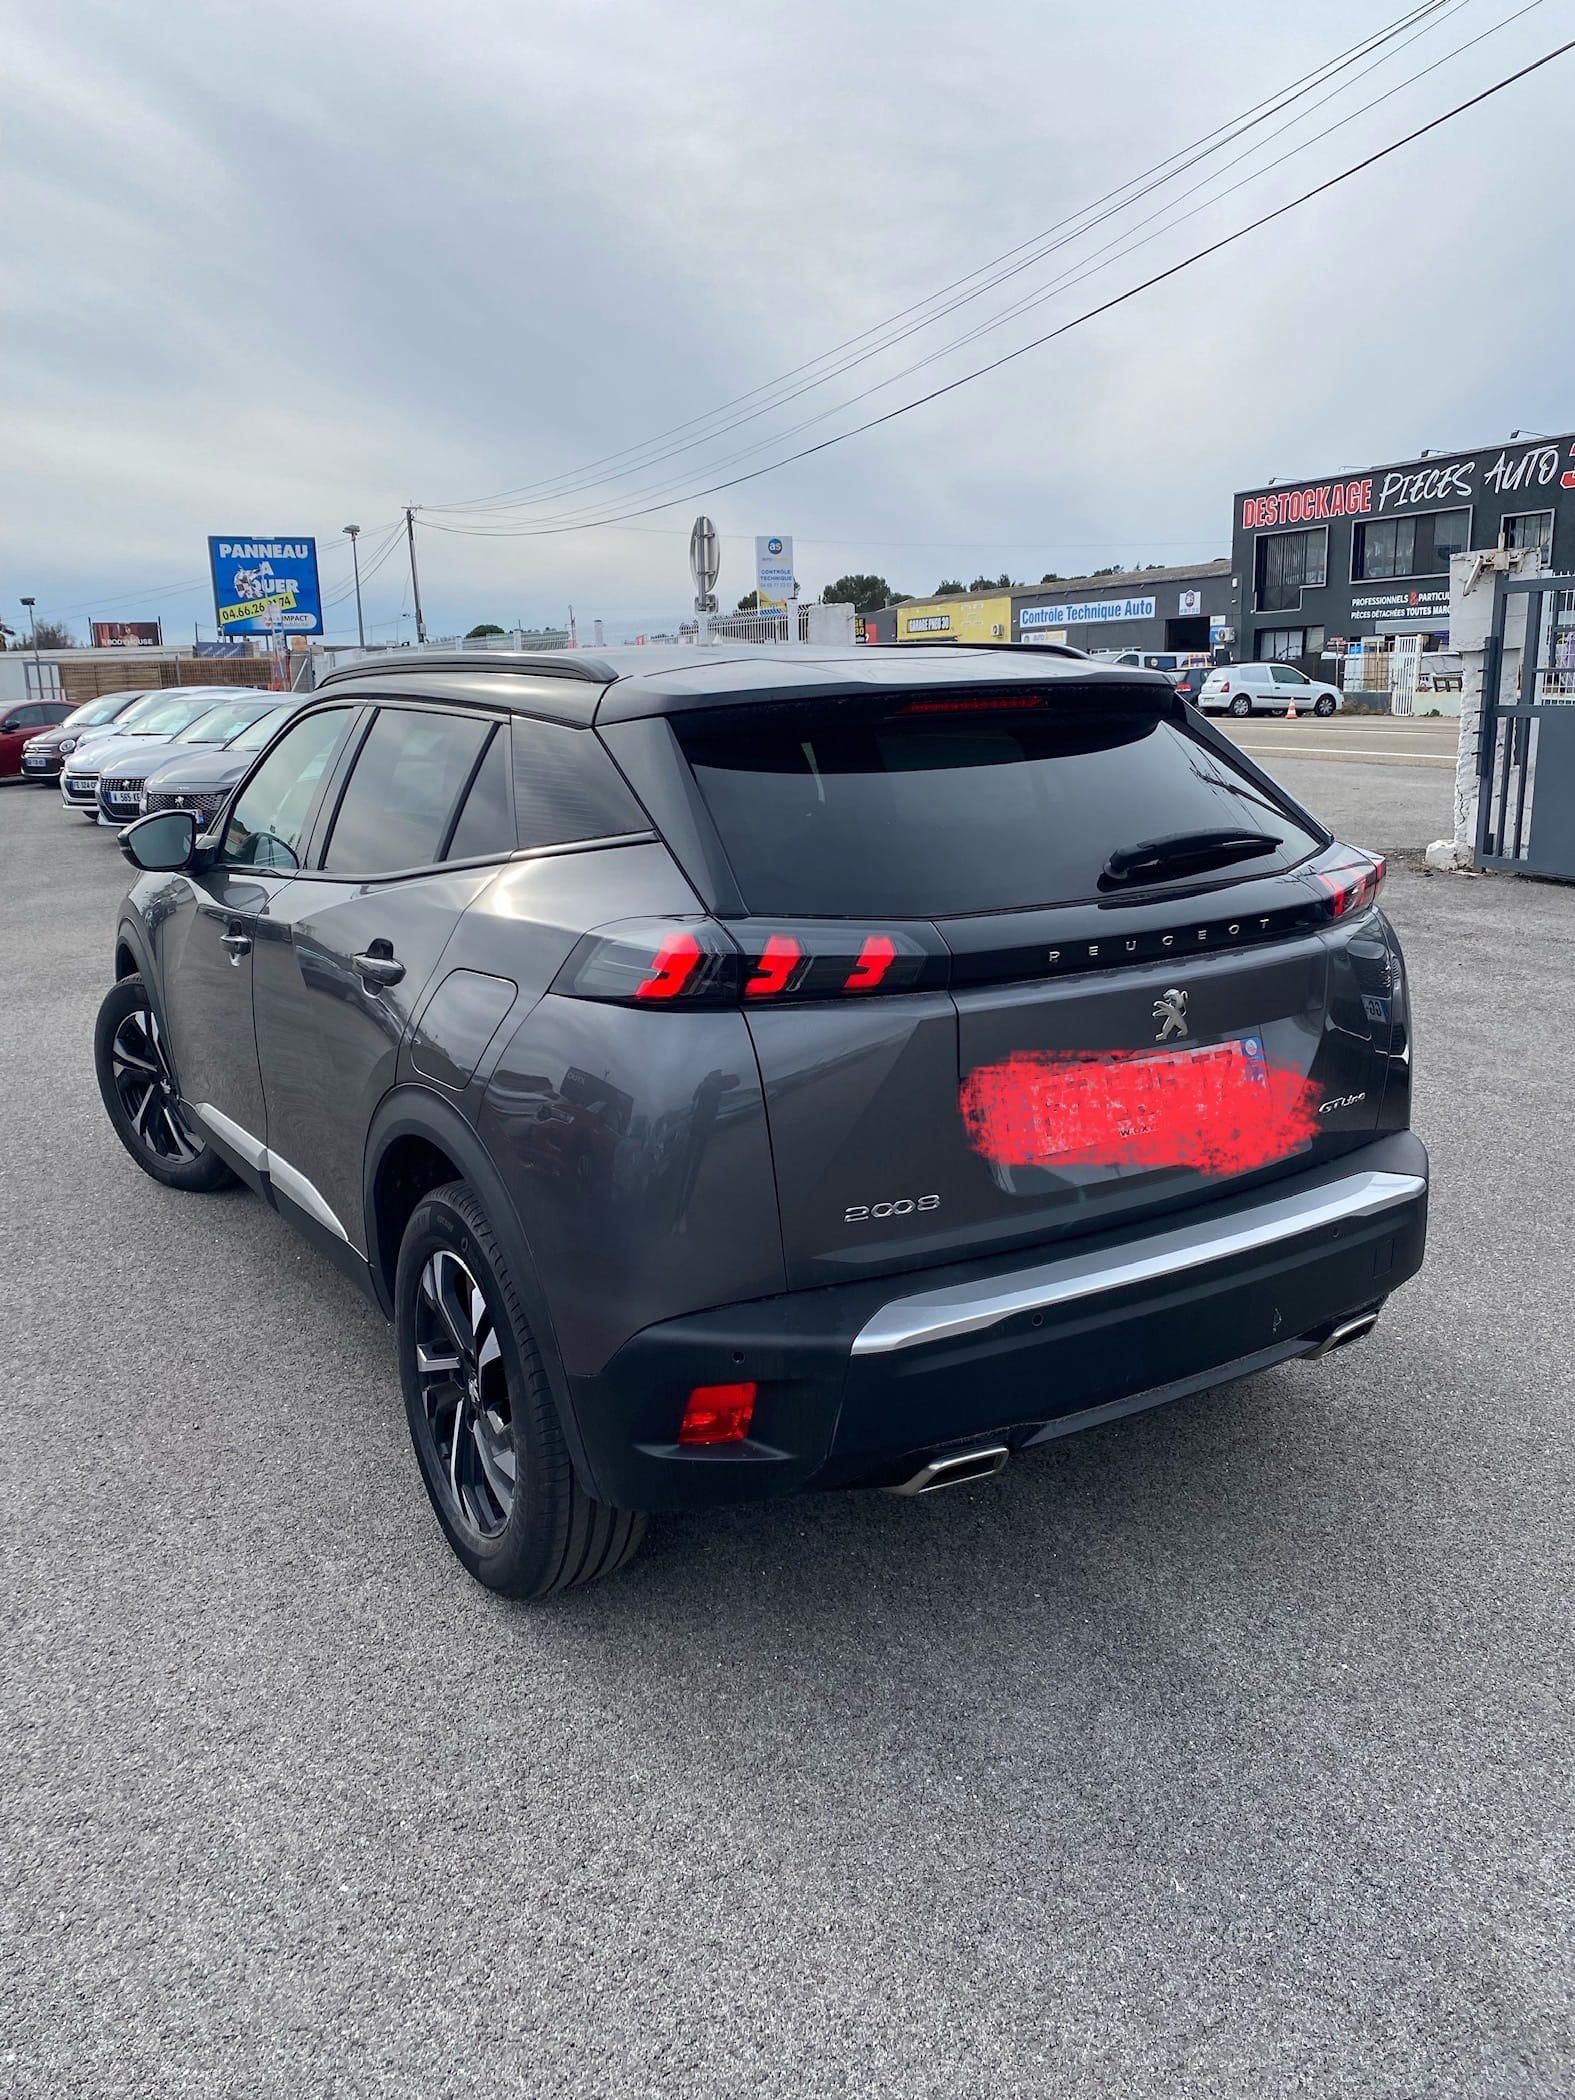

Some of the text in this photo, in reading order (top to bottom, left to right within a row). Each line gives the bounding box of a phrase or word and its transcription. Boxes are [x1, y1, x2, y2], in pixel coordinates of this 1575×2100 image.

[1243, 479, 1373, 529] DESTOCKAGE
[1379, 462, 1476, 512] PIECES
[1484, 445, 1560, 494] AUTO
[219, 543, 309, 559] PANNEAU
[1066, 602, 1121, 621] Technique
[1125, 600, 1152, 616] Auto
[1352, 594, 1409, 607] PROFESSIONNELS
[1406, 606, 1432, 616] TOUTES
[1048, 918, 1270, 962] PEUGEOT
[844, 1194, 940, 1222] 2008
